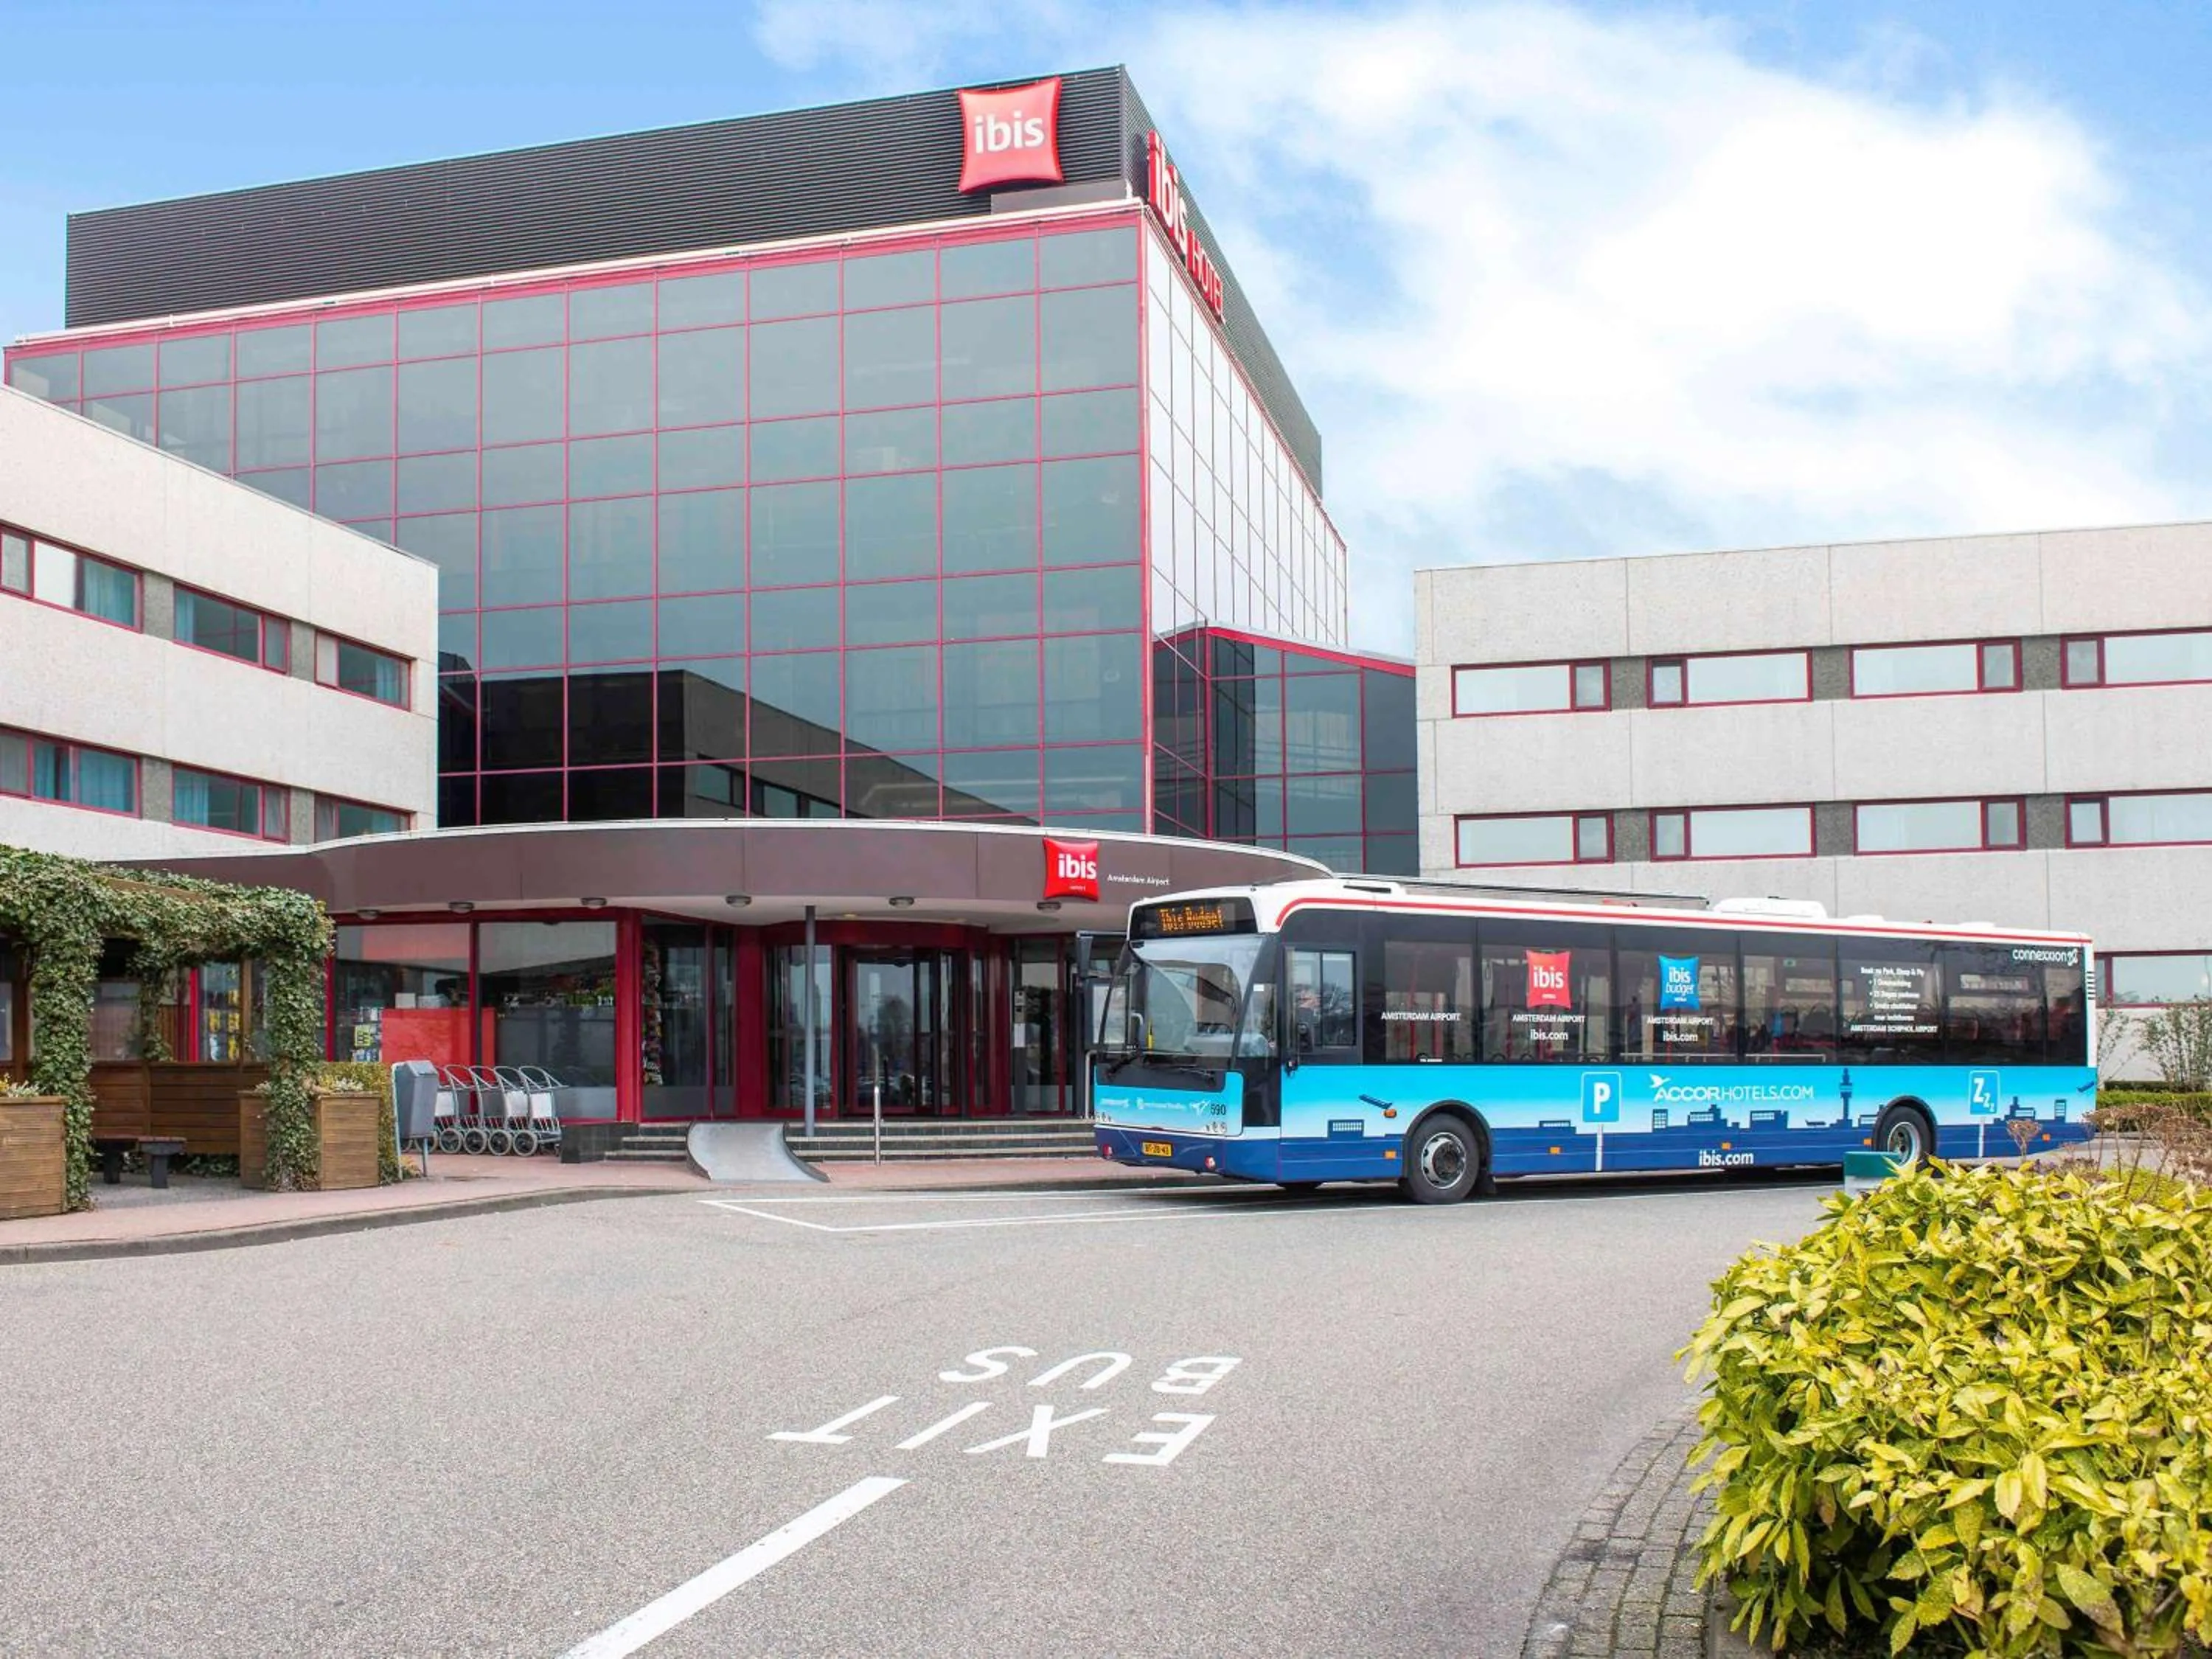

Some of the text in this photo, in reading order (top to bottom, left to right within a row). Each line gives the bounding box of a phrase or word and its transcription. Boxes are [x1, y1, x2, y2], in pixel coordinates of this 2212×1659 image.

[974, 110, 1045, 154] ibis
[1148, 130, 1225, 322] ibis HOTEL
[1058, 853, 1097, 880] ibis
[1107, 874, 1170, 886] Amsterdam Airport
[2012, 949, 2067, 962] connexxion
[1533, 965, 1565, 989] ibis
[1669, 967, 1691, 983] ibis
[1665, 982, 1694, 998] budget
[1381, 1012, 1461, 1021] AMSTERDAM AIRPORT
[1512, 1014, 1585, 1023] AMSTERDAM AIRPORT
[1647, 1016, 1714, 1026] AMSTERDAM AIRPORT
[1530, 1029, 1568, 1040] ibis.com
[1663, 1030, 1699, 1041] ibis.com
[1593, 1082, 1611, 1114] P
[1654, 1085, 1815, 1102] ACCORHOTELS.COM
[1210, 1103, 1226, 1116] 590
[1699, 1150, 1754, 1166] ibis.com
[939, 1346, 1243, 1394] BUS
[765, 1395, 1217, 1466] EXIT
